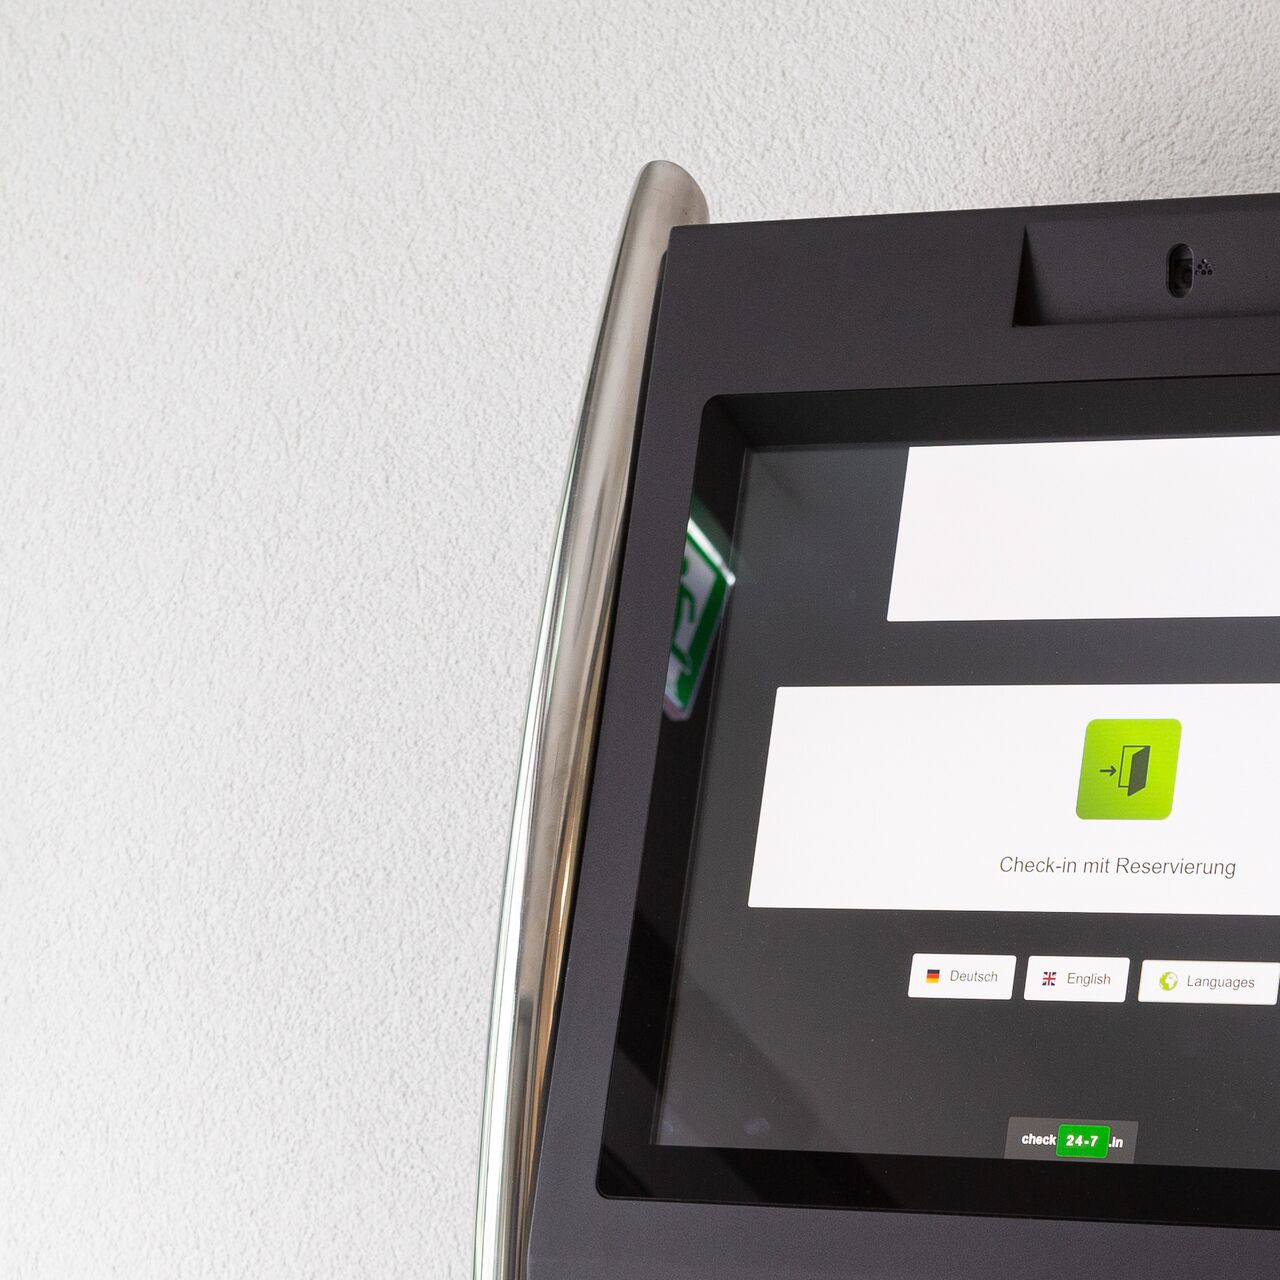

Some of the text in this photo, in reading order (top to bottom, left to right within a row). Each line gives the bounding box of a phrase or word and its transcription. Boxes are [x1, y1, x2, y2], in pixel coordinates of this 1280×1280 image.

[999, 856, 1237, 880] Check-in mit Reservierung
[949, 969, 999, 983] Deutsch
[1066, 972, 1112, 987] English
[1186, 975, 1256, 990] Languages
